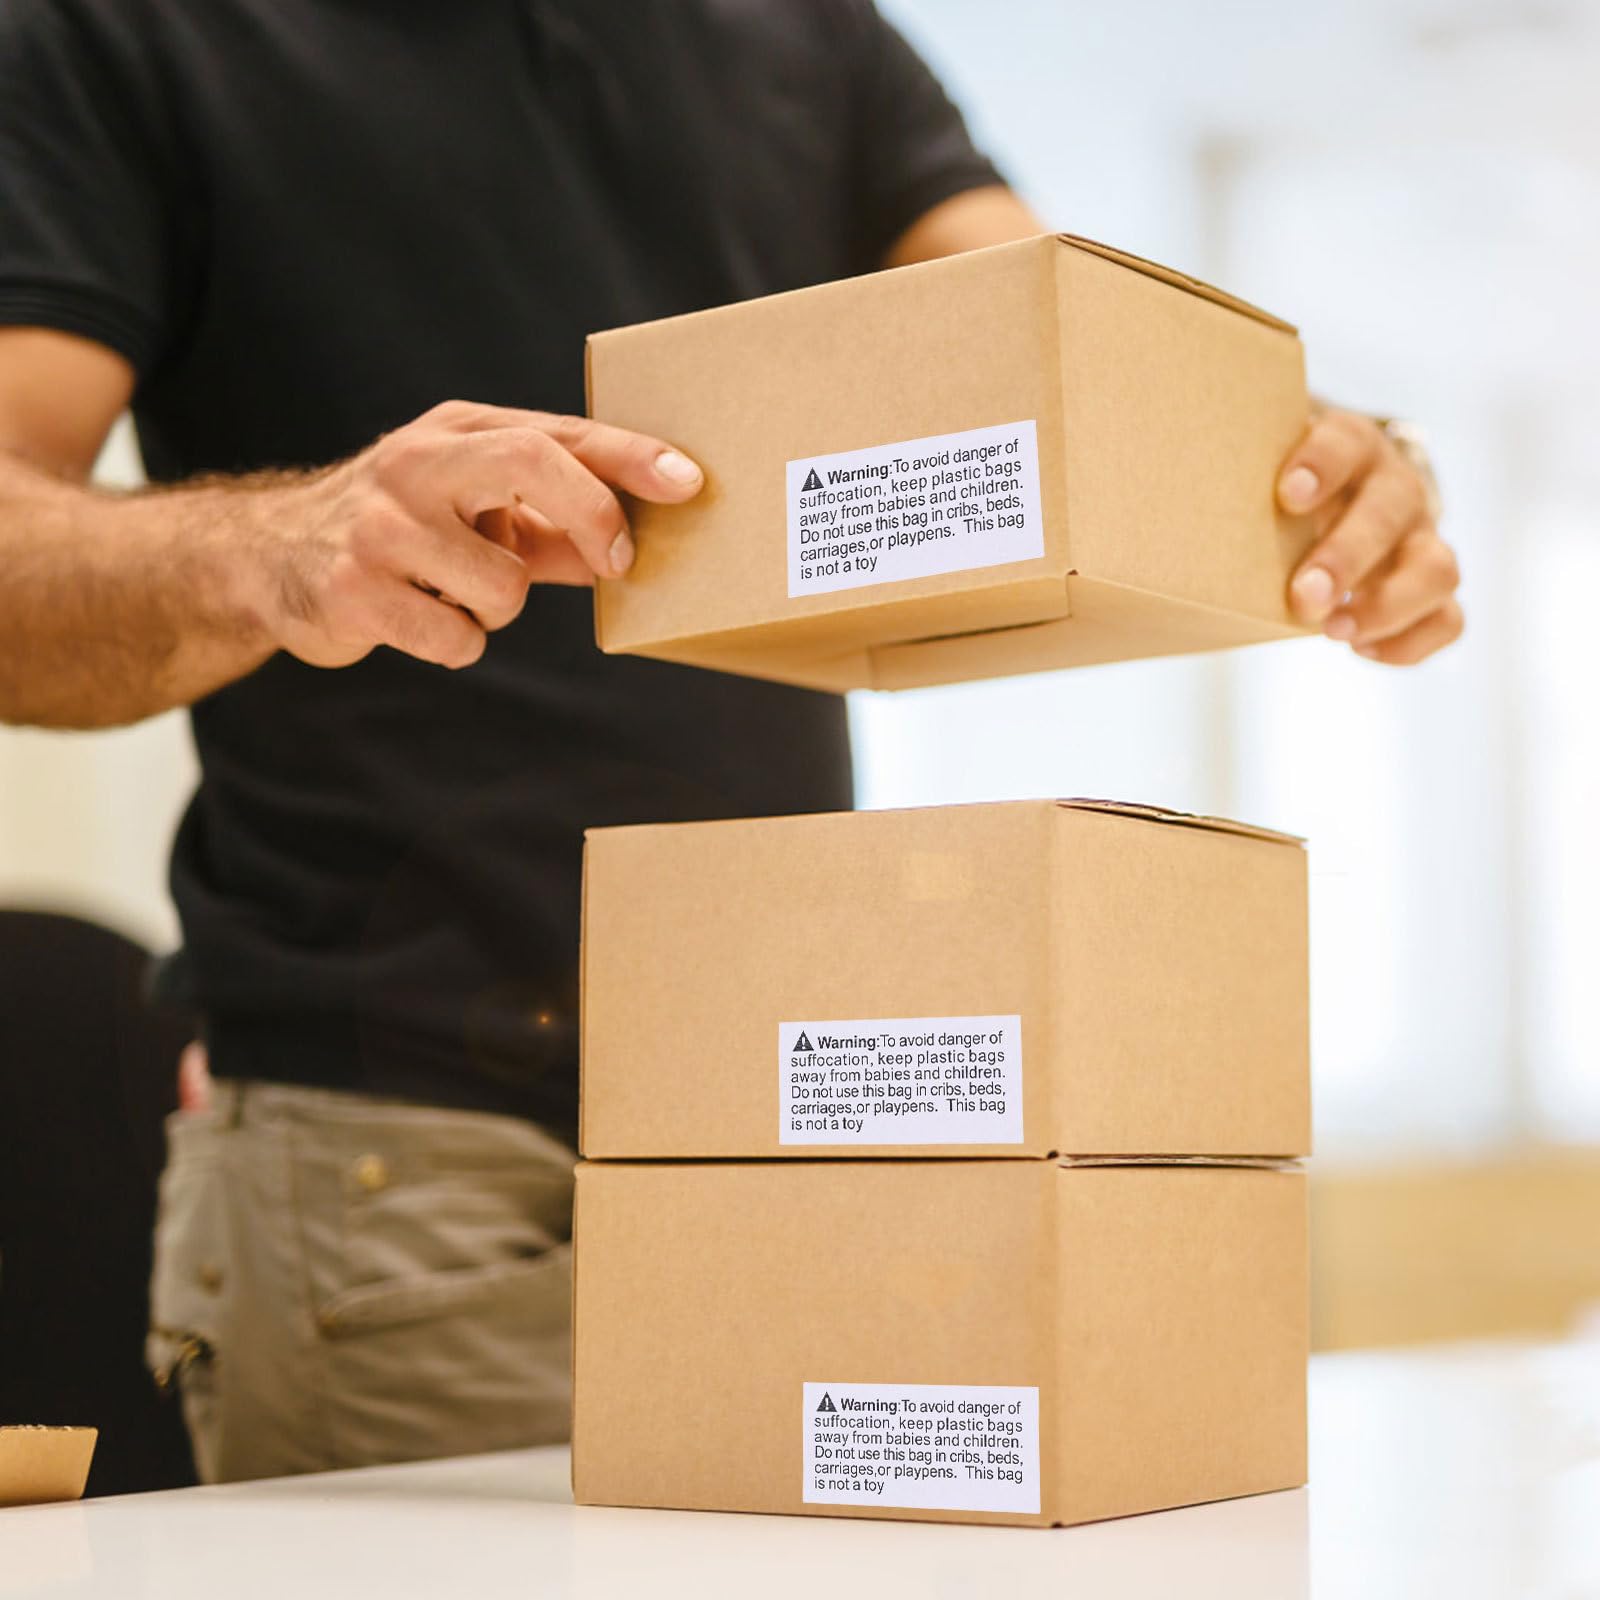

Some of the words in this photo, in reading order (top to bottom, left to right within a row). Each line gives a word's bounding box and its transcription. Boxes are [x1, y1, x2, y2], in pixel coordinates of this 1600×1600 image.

[912, 450, 950, 471] avoid
[952, 444, 1003, 464] danger
[1004, 438, 1019, 454] of
[799, 484, 887, 509] suffocation,
[891, 476, 928, 494] keep
[932, 465, 981, 488] plastic
[984, 460, 1022, 478] bags
[799, 509, 838, 527] away
[840, 503, 874, 520] from
[877, 491, 926, 513] babies
[929, 485, 957, 505] and
[960, 478, 1024, 499] children.
[800, 528, 820, 545] Do
[823, 523, 845, 541] not
[847, 521, 873, 536] use
[875, 514, 900, 532] this
[902, 512, 928, 528] bag
[931, 507, 944, 523] in
[946, 501, 983, 521] cribs,
[986, 494, 1024, 516] beds,
[887, 525, 956, 551] playpens.
[962, 516, 994, 534] This
[997, 513, 1025, 529] bag
[800, 564, 813, 580] is
[816, 559, 840, 577] not
[842, 560, 852, 573] a
[855, 556, 878, 573] toy
[899, 1032, 935, 1048] avoid
[937, 1032, 987, 1049] danger
[989, 1030, 1003, 1045] of
[791, 1052, 874, 1068] suffocation,
[877, 1051, 913, 1068] keep
[917, 1049, 965, 1068] plastic
[968, 1048, 1005, 1066] bags
[790, 1072, 827, 1086] away
[830, 1068, 861, 1082] from
[864, 1066, 911, 1082] babies
[914, 1066, 940, 1081] and
[944, 1064, 1006, 1080] children.
[791, 1085, 810, 1099] Do
[812, 1084, 834, 1099] not
[836, 1087, 860, 1098] use
[862, 1083, 885, 1098] this
[887, 1083, 912, 1101] bag
[916, 1082, 927, 1097] in
[930, 1082, 966, 1098] cribs,
[968, 1081, 1006, 1097] beds,
[873, 1098, 939, 1117] playpens.
[945, 1097, 976, 1112] This
[979, 1097, 1006, 1115] bag
[791, 1117, 803, 1131] is
[806, 1117, 828, 1131] not
[830, 1119, 839, 1130] a
[842, 1116, 864, 1133] toy
[919, 1399, 955, 1414] avoid
[957, 1400, 1006, 1418] danger
[1007, 1401, 1022, 1415] of
[814, 1414, 895, 1432] suffocation,
[899, 1416, 933, 1434] keep
[936, 1416, 984, 1434] plastic
[987, 1418, 1023, 1436] bags
[814, 1433, 849, 1447] away
[852, 1430, 883, 1445] from
[886, 1431, 931, 1446] babies
[934, 1433, 960, 1447] and
[963, 1433, 1023, 1449] children.
[814, 1445, 833, 1459] Do
[835, 1445, 856, 1460] not
[858, 1449, 881, 1461] use
[883, 1447, 906, 1462] this
[908, 1447, 932, 1466] bag
[935, 1448, 947, 1463] in
[949, 1449, 986, 1466] cribs,
[987, 1450, 1024, 1467] beds,
[894, 1463, 957, 1481] playpens.
[964, 1465, 994, 1480] This
[997, 1466, 1023, 1485] bag
[814, 1476, 826, 1490] is
[828, 1477, 850, 1491] not
[852, 1480, 861, 1491] a
[863, 1478, 885, 1496] toy
